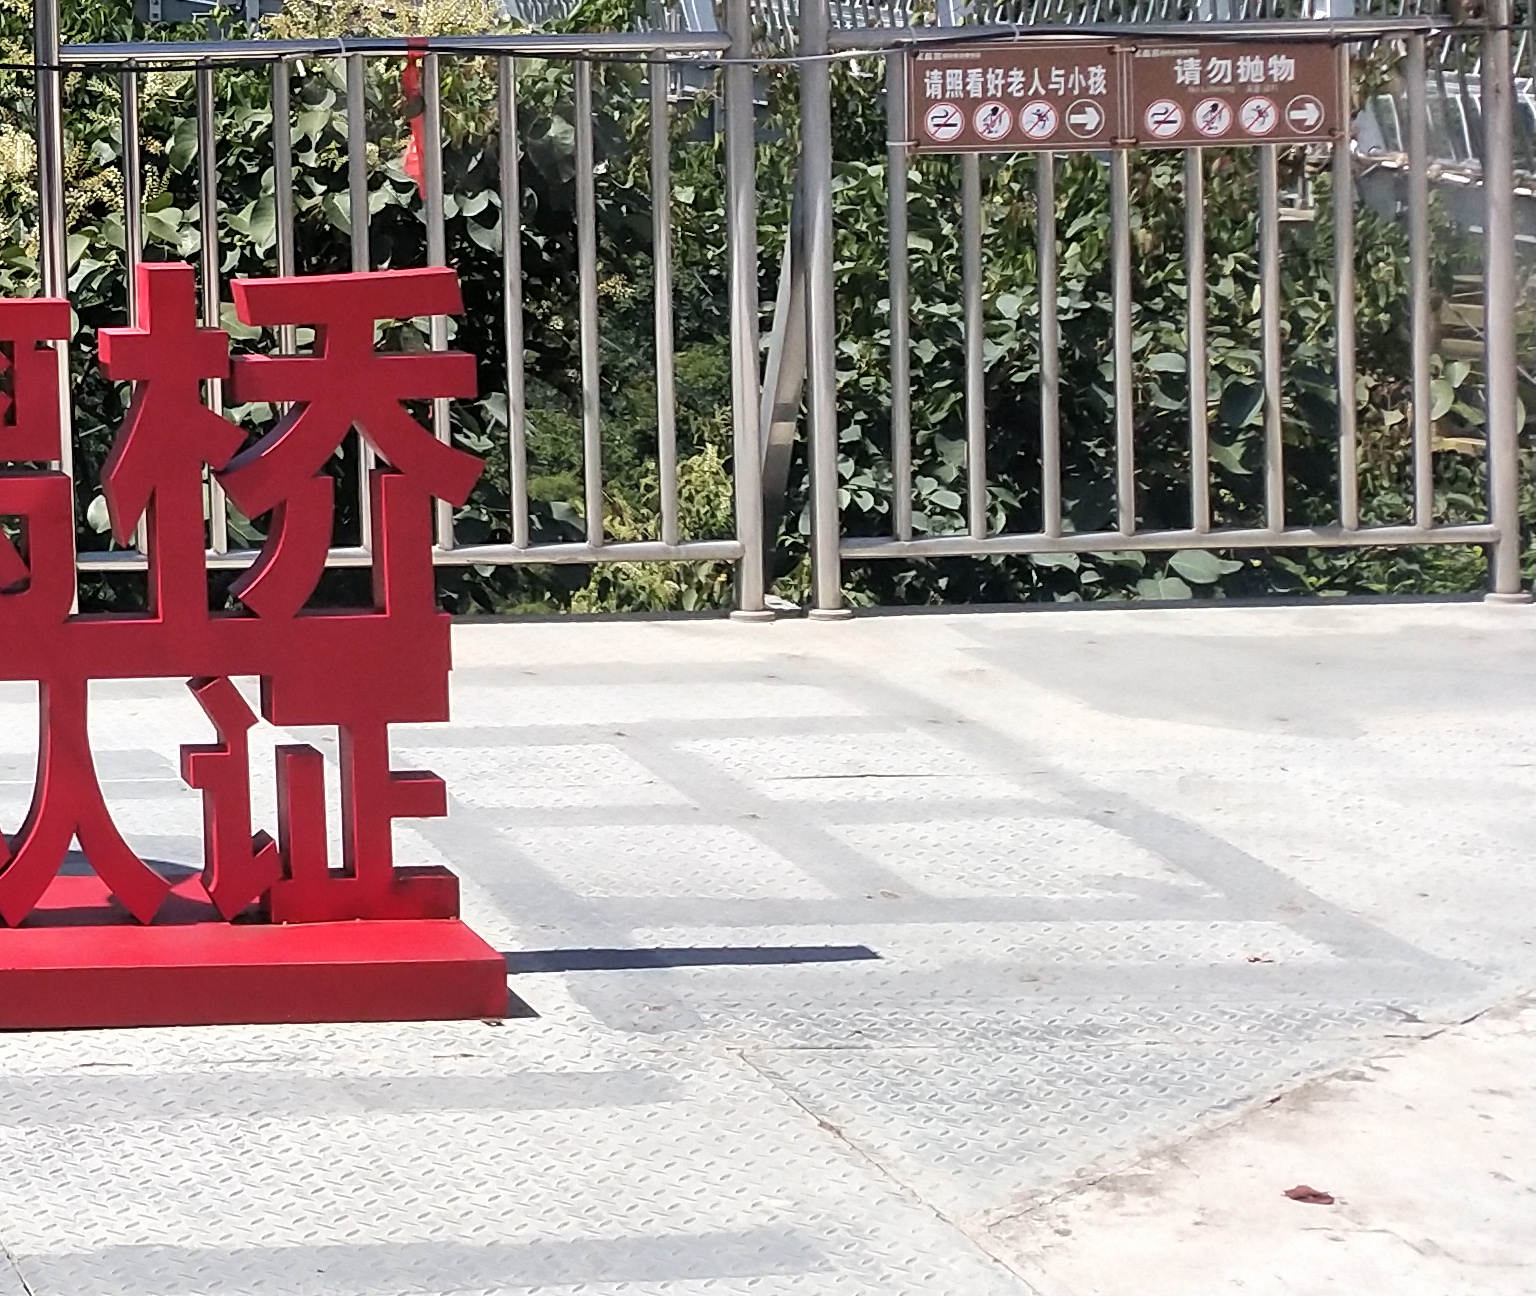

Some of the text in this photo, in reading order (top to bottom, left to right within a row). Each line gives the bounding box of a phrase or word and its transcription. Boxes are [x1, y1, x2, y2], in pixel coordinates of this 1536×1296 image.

[923, 64, 1108, 99] 请照看好老人与小孩
[1174, 54, 1295, 85] 请勿抛物
